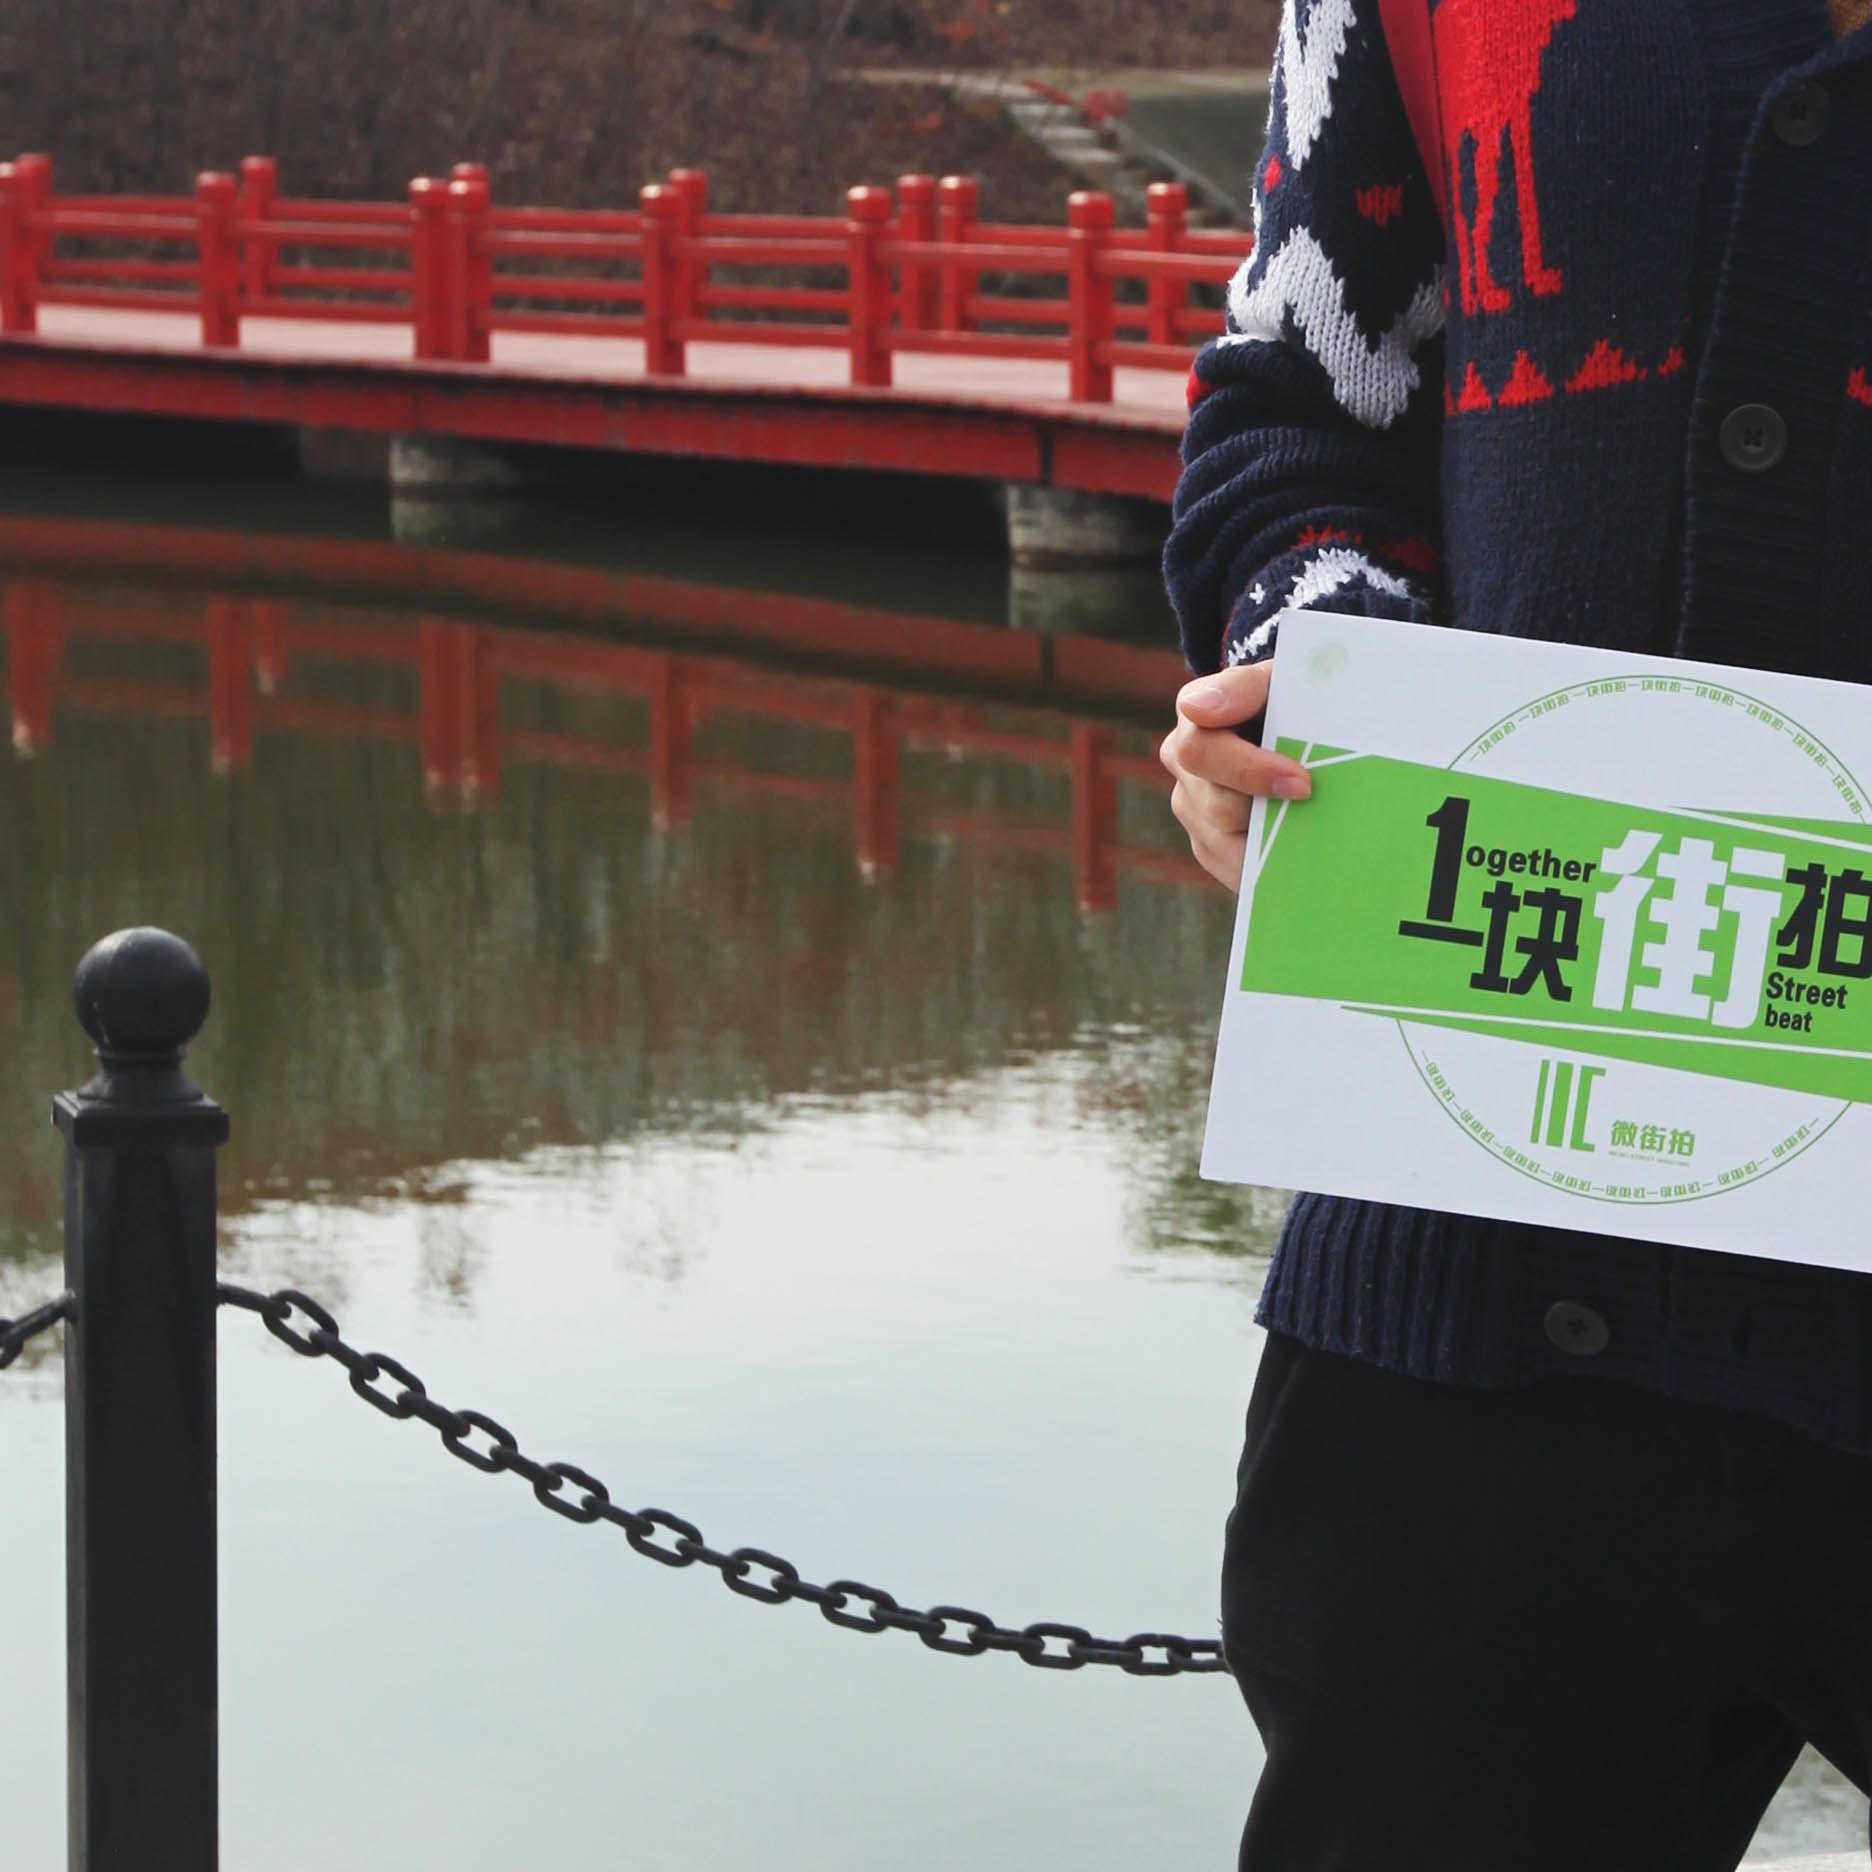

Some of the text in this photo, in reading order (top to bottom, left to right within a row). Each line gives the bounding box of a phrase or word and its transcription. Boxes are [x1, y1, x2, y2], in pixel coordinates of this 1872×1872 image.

[1766, 972, 1847, 1008] Street
[1765, 1003, 1813, 1032] beat
[1610, 1120, 1696, 1156] 微街拍
